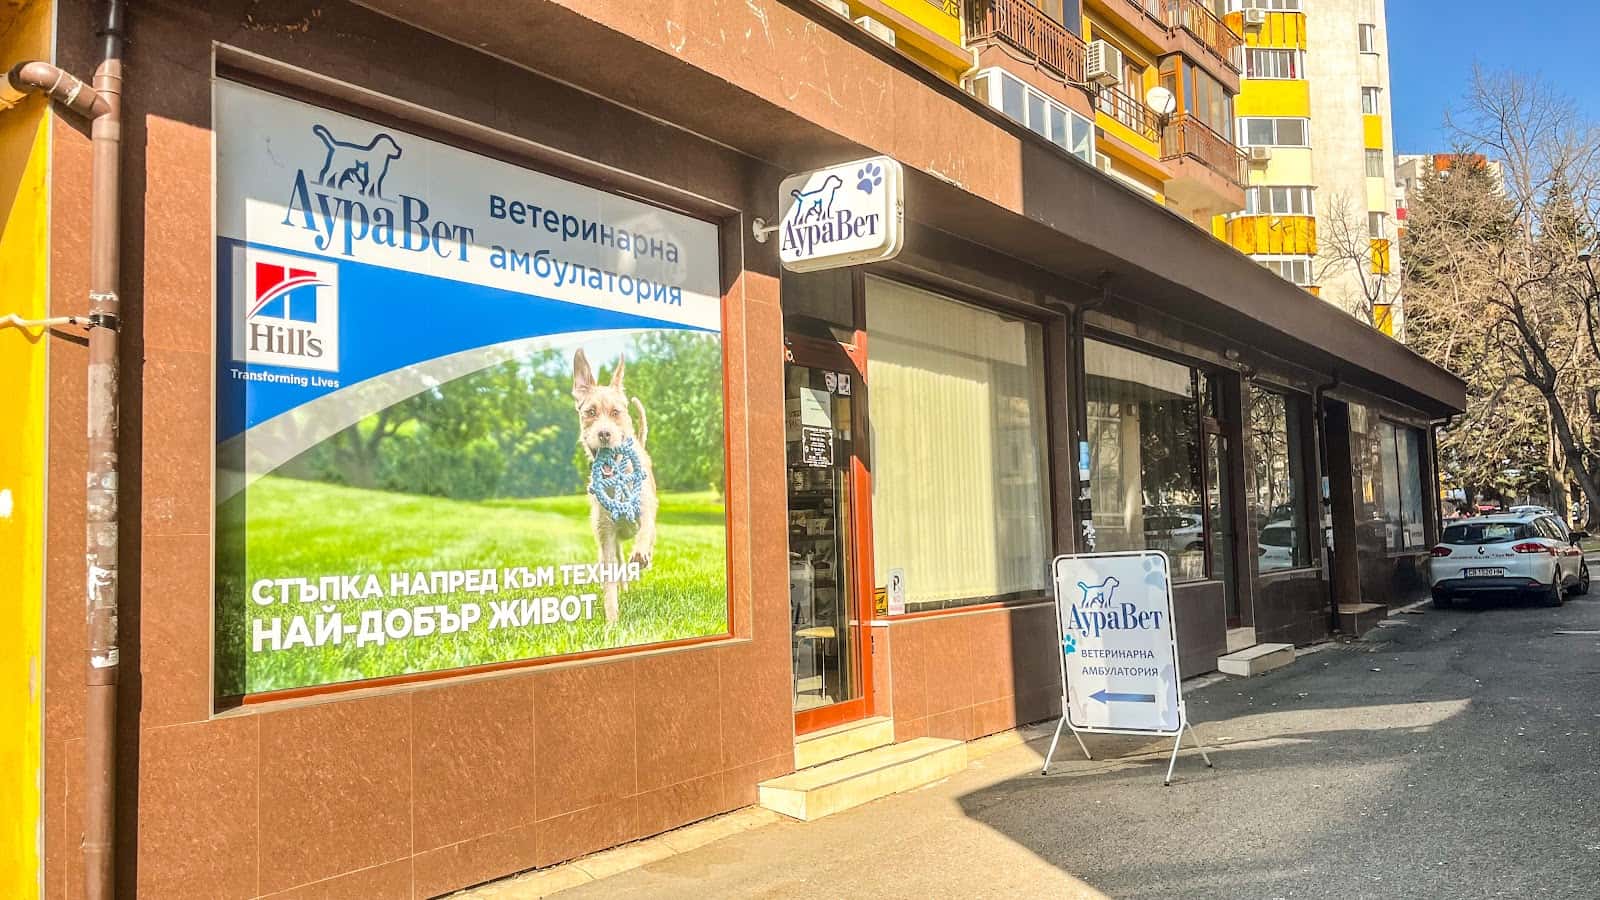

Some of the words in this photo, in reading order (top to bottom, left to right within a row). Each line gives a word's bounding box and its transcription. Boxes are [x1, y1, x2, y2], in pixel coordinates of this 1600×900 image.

[281, 169, 474, 262] АураВет
[490, 195, 679, 264] ветеринарна
[782, 209, 880, 257] АураВет
[490, 245, 682, 307] амбулатория
[249, 322, 323, 358] Hill's
[230, 368, 308, 387] Transforming
[311, 376, 340, 389] Lives
[251, 574, 384, 606] СТЪПКА
[391, 568, 498, 597] НАПРЕД
[504, 566, 554, 589] КЪМ
[559, 562, 641, 586] ТЕХНИЯ
[252, 603, 481, 653] НАЙ-ДОБЪР
[488, 594, 598, 630] ЖИВОТ
[1068, 602, 1163, 638] АураВет
[1081, 649, 1155, 659] ВЕТЕРИНАРНА
[1082, 666, 1158, 676] АМБУЛАТОРИЯ
